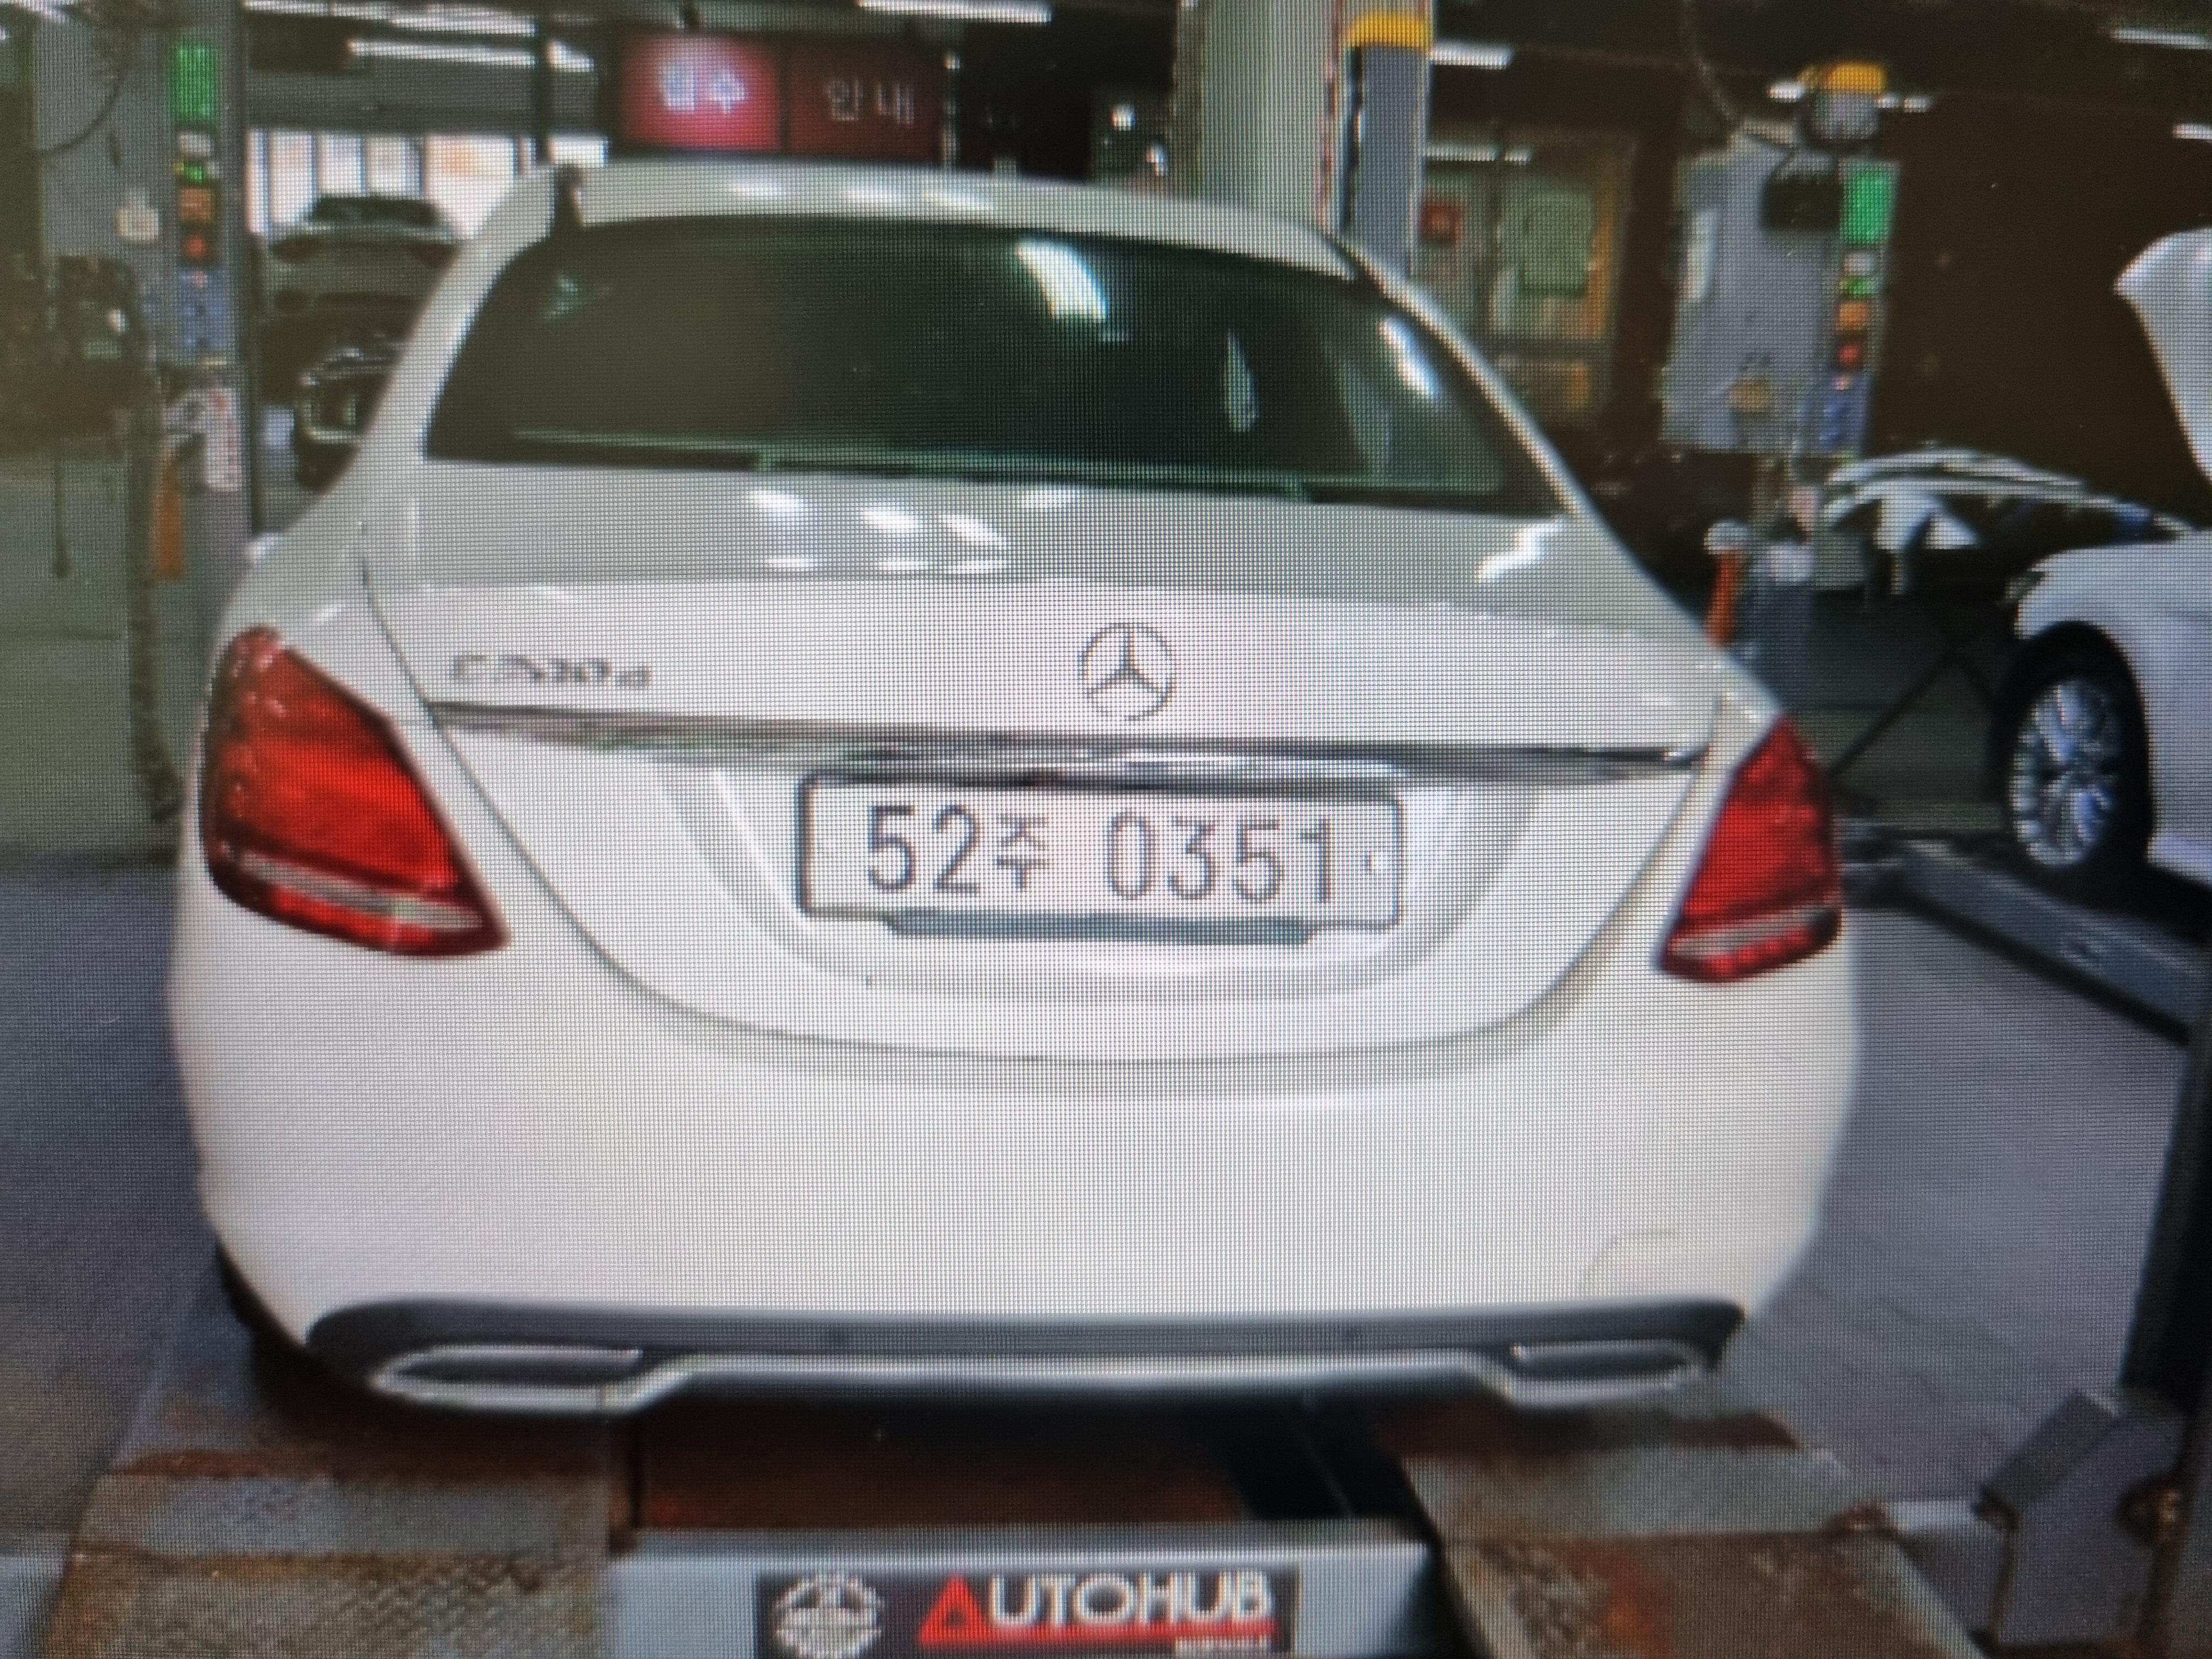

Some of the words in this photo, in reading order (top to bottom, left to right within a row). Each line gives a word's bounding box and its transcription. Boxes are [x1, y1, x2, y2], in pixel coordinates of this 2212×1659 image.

[866, 801, 1048, 894] 52주
[1104, 809, 1332, 905] 0351
[917, 1572, 1272, 1646] AUTOHUB
